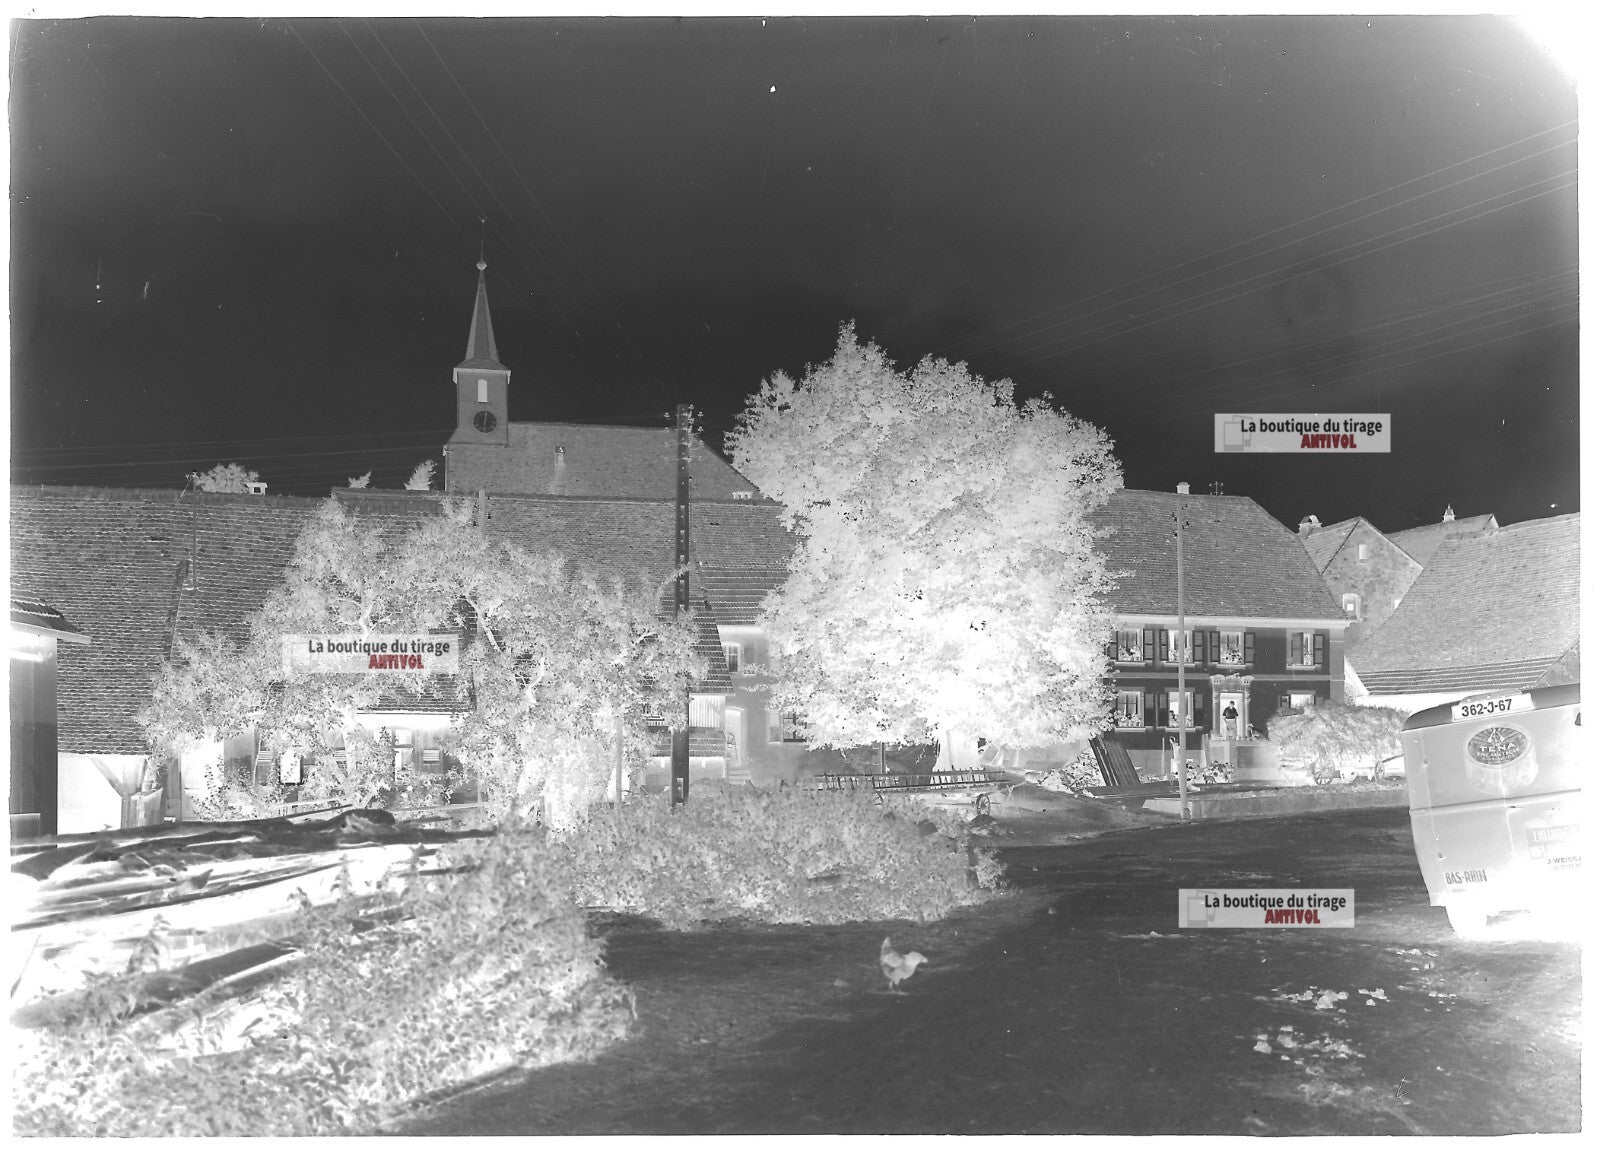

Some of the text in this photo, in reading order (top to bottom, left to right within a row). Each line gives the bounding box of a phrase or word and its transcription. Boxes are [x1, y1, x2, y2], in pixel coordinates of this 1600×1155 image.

[1461, 698, 1512, 717] 362-J-67
[1479, 742, 1516, 752] TENA
[1445, 869, 1488, 885] BAS-RHIN
